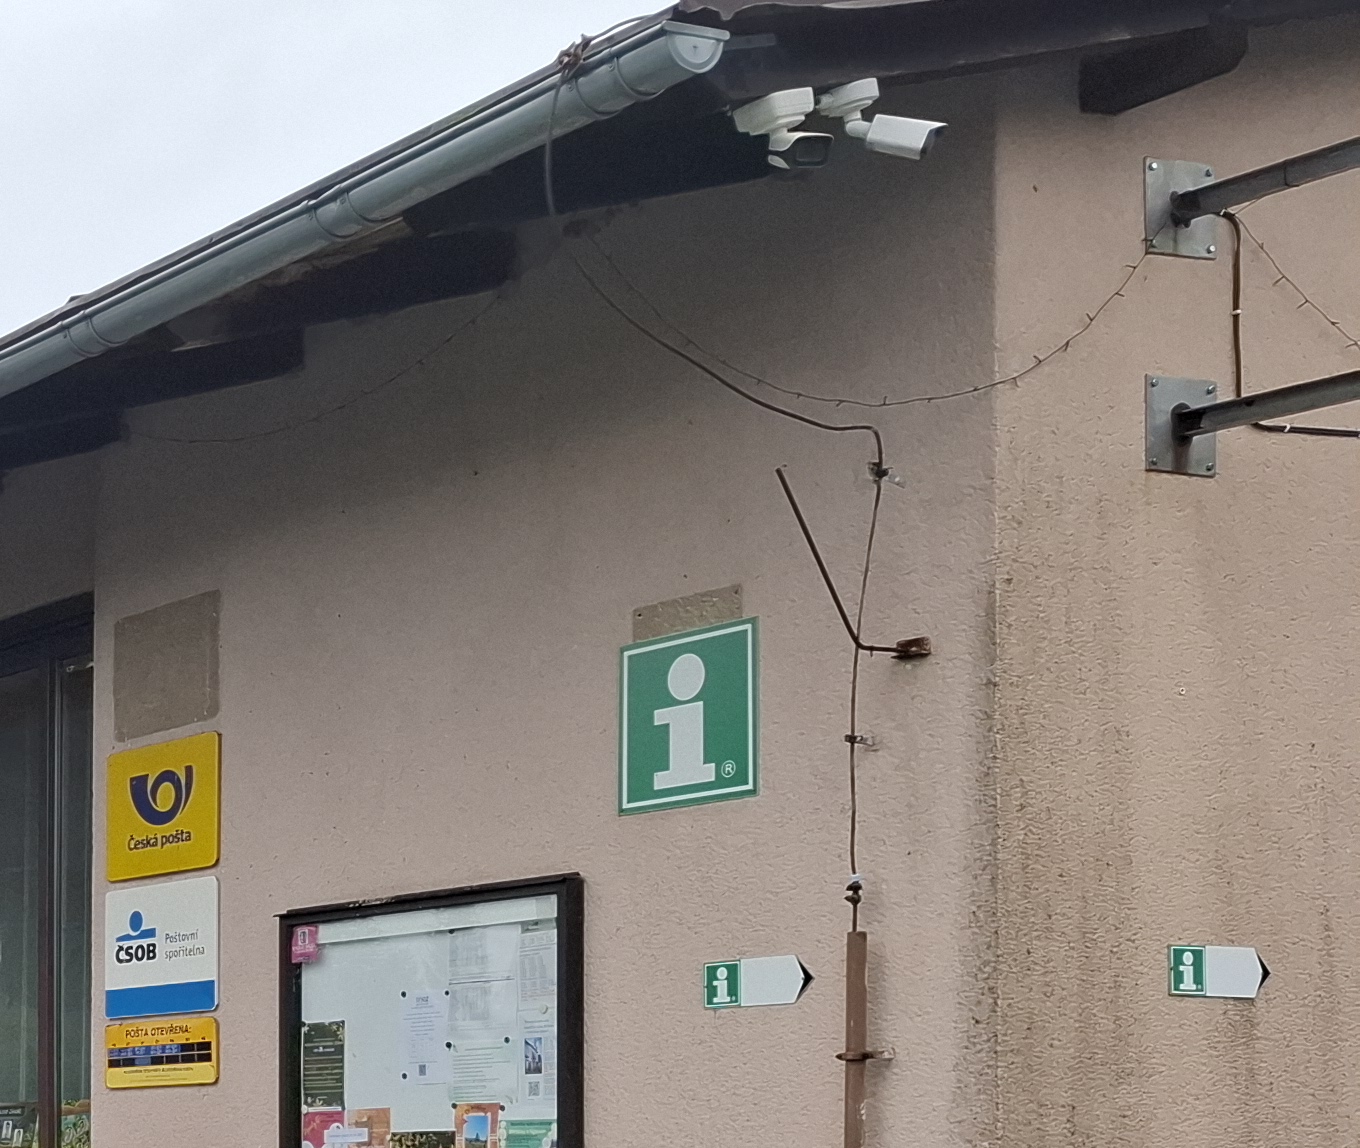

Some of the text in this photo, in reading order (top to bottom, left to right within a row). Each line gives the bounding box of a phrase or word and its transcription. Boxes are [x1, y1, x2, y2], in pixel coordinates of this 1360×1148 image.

[128, 830, 191, 851] Česká pošta
[165, 929, 199, 944] Poštovní
[115, 943, 157, 964] ČSOB
[164, 945, 205, 960] spořitelna
[125, 1027, 149, 1039] POŠTA
